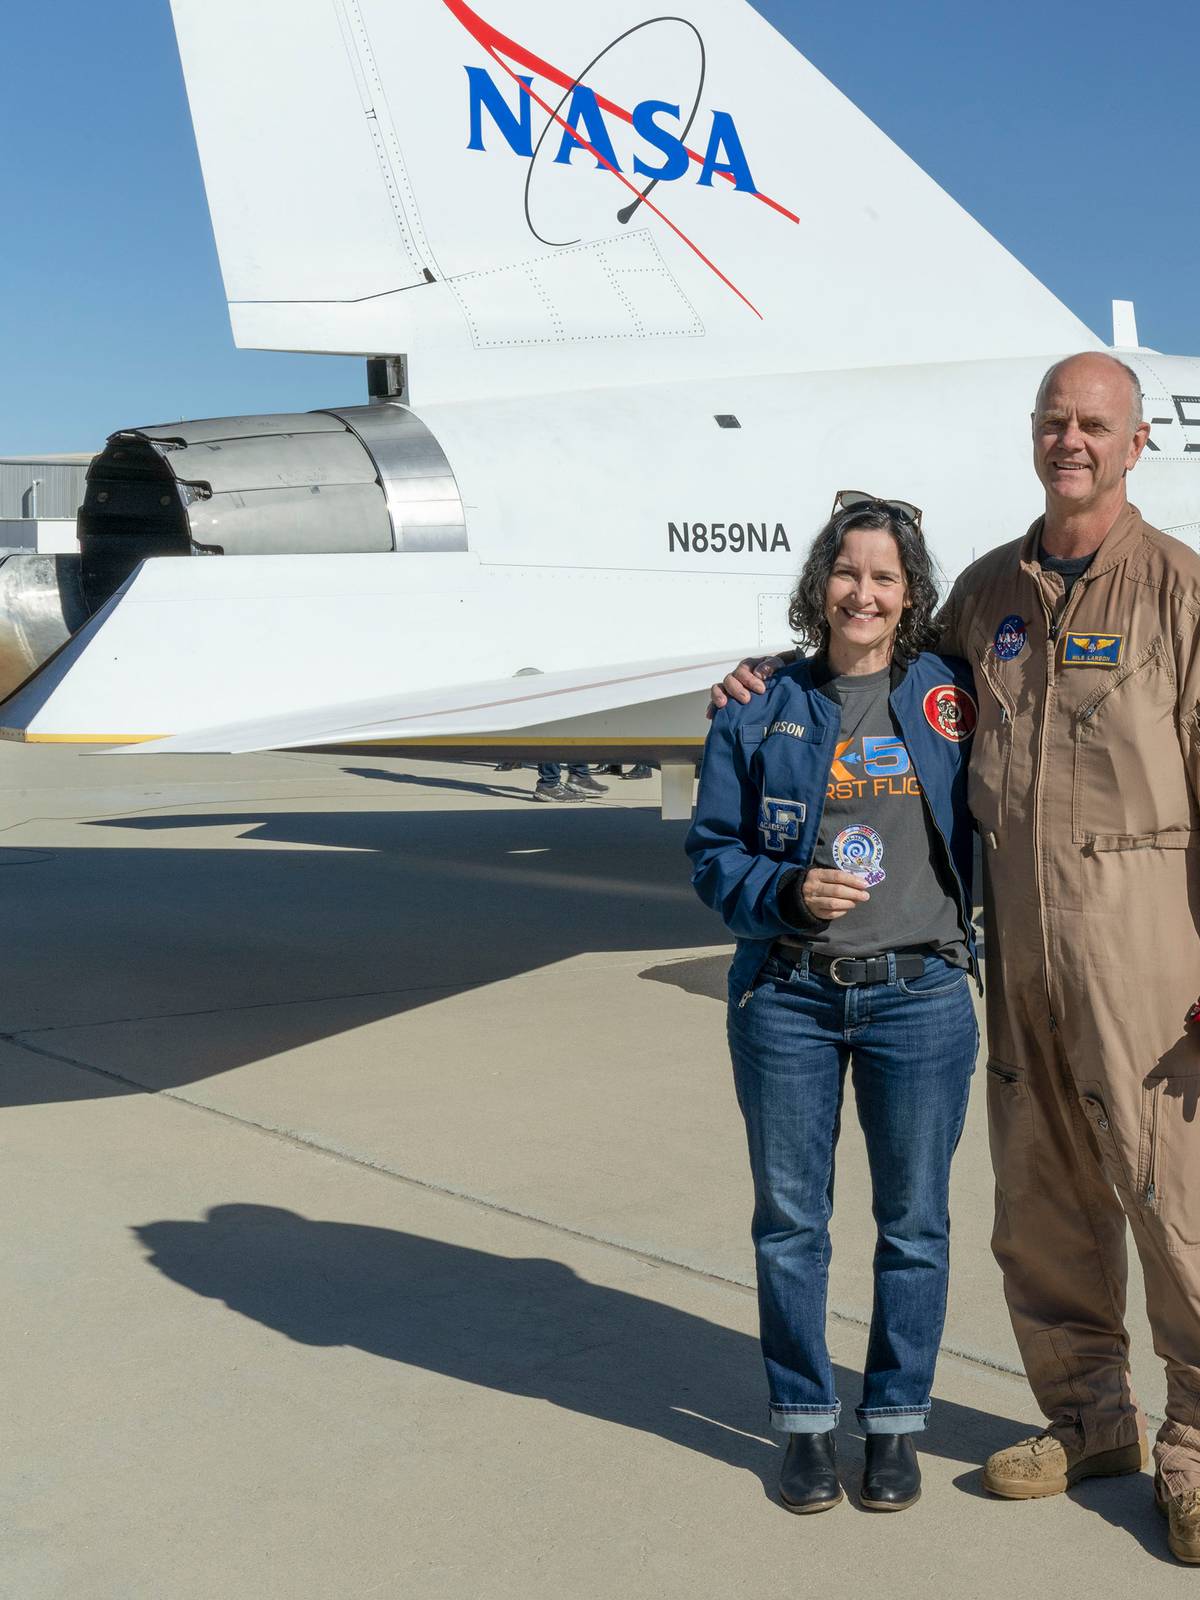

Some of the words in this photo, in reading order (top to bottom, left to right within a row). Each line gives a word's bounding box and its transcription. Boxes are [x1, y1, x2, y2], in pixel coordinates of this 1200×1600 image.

[463, 65, 760, 194] NASA
[667, 522, 791, 553] N859NA
[873, 777, 921, 797] FLIG
